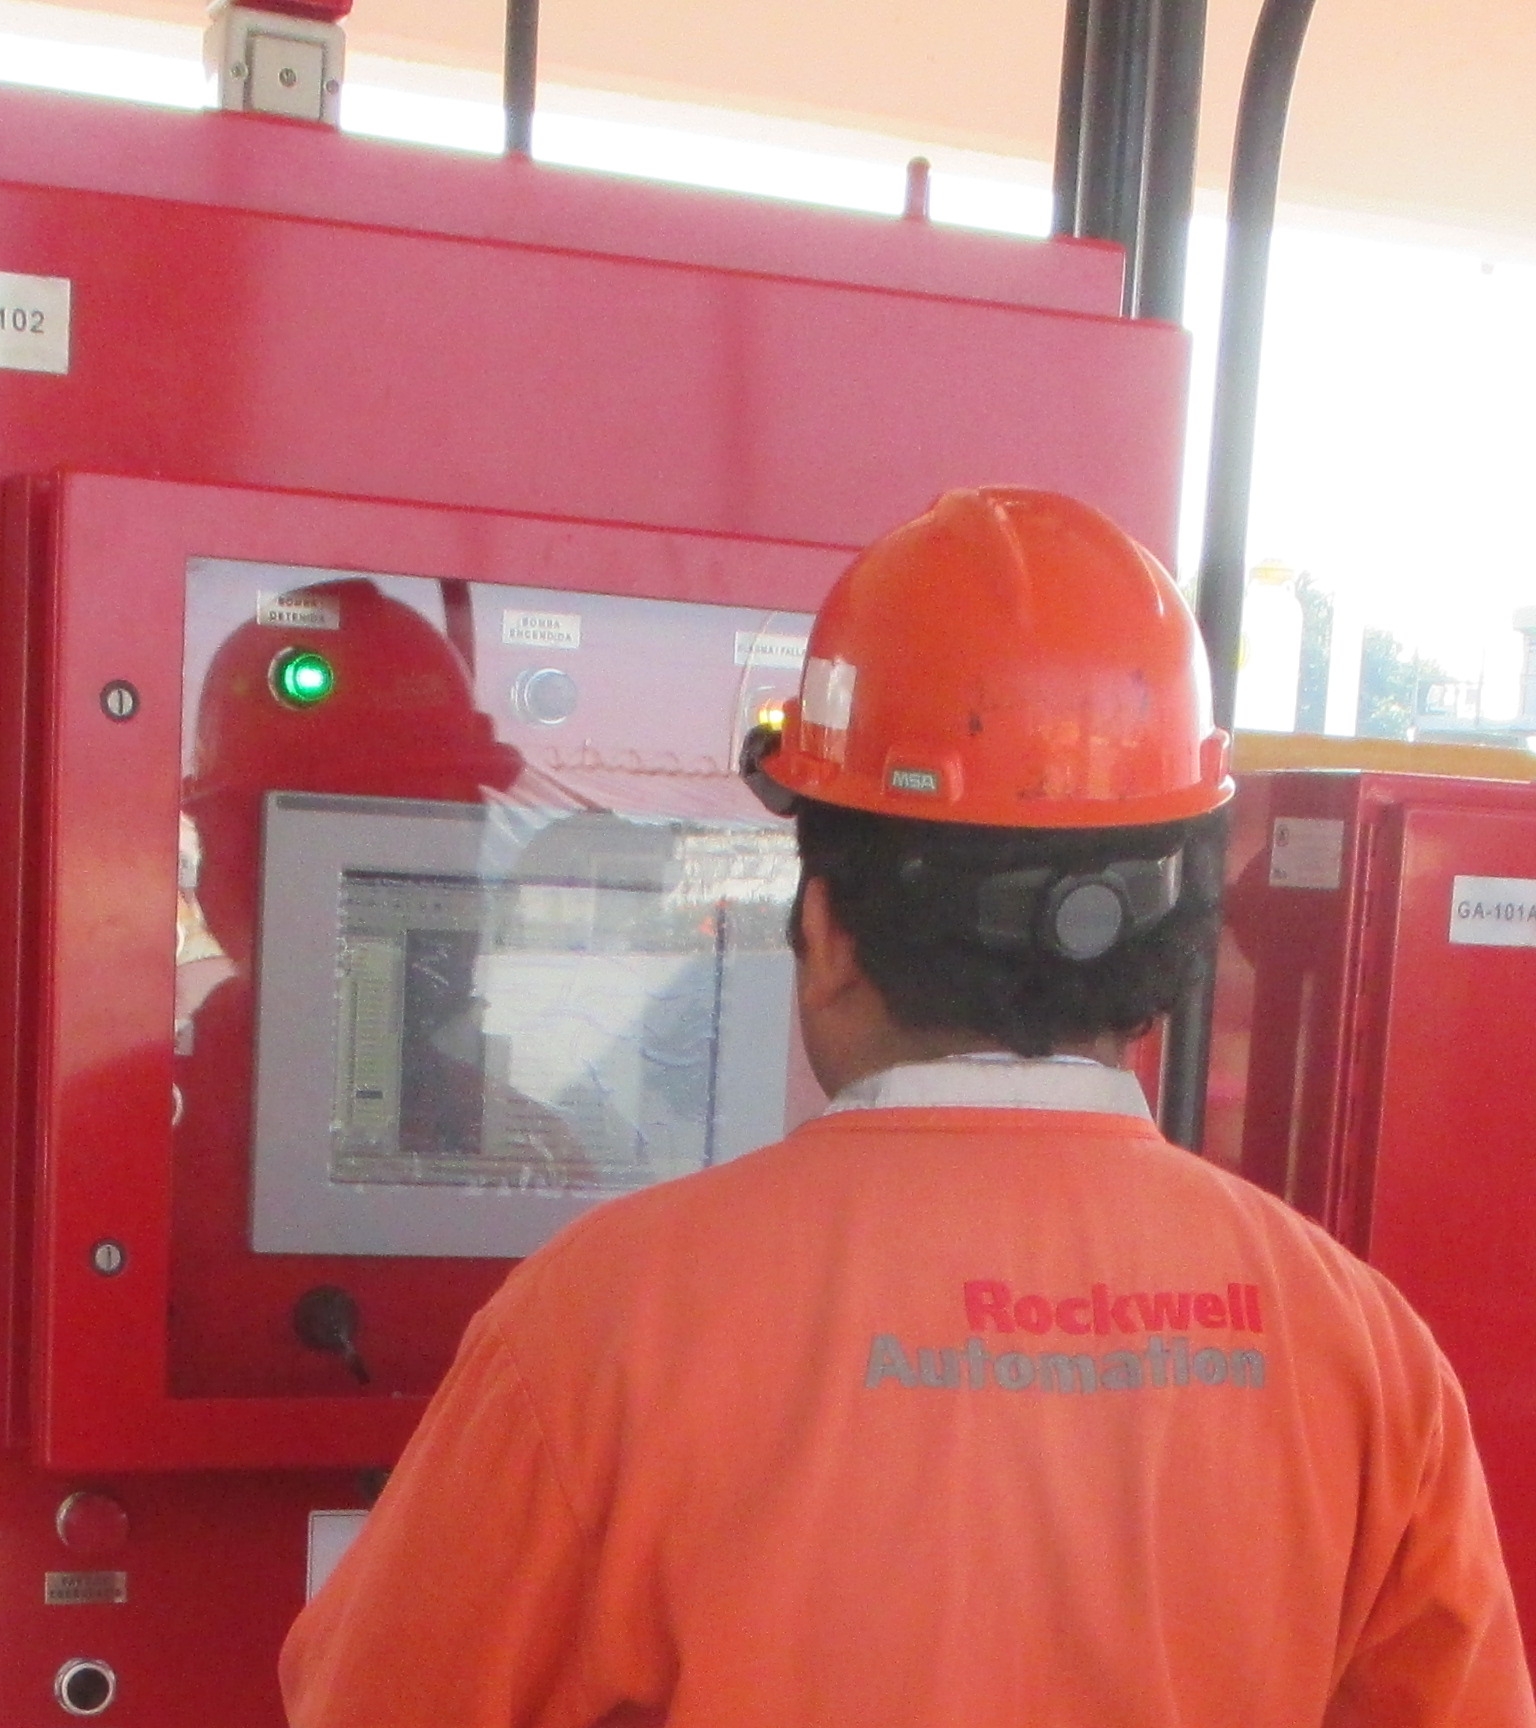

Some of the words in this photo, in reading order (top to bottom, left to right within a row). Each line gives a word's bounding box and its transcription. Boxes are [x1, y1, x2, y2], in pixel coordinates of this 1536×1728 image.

[521, 617, 560, 629] BOMBA
[893, 770, 935, 789] MSA
[964, 1279, 1264, 1336] Rockwell
[865, 1333, 1265, 1395] Automation
